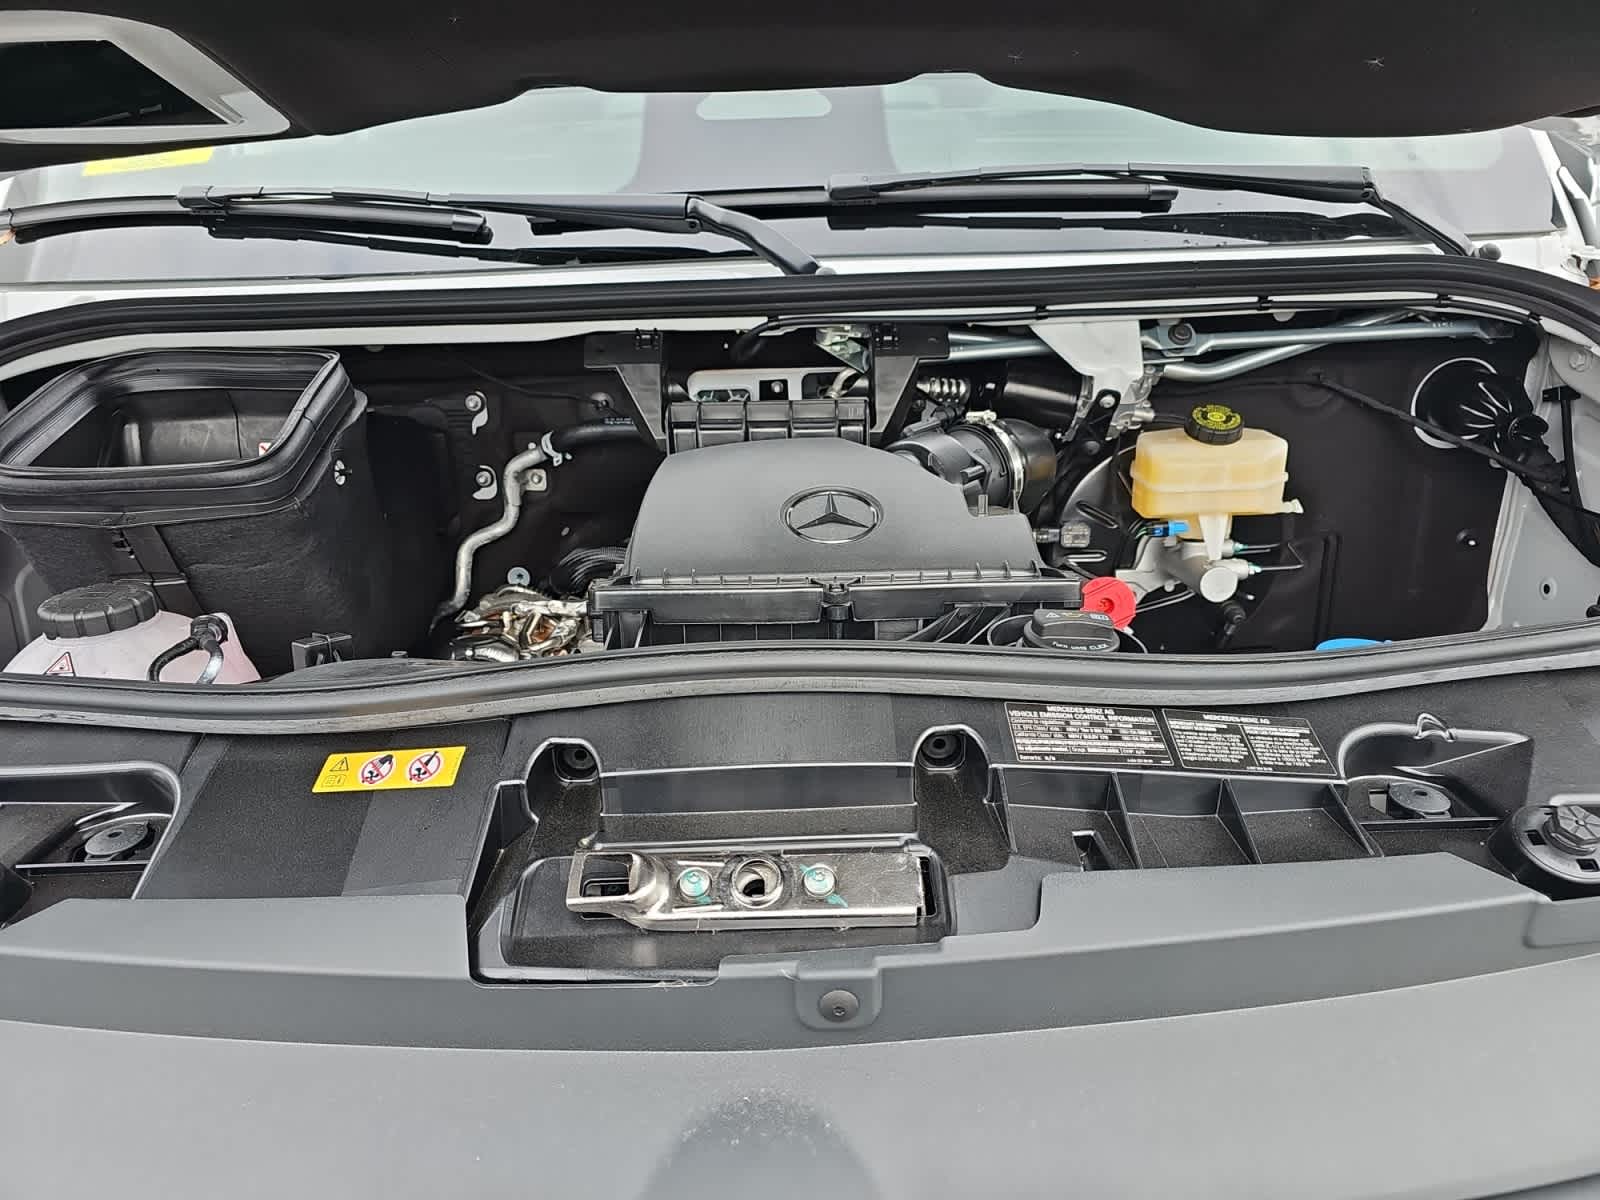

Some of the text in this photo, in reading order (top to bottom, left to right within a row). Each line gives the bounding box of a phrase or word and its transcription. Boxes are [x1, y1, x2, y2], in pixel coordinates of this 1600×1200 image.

[1046, 705, 1103, 714] MERCEDES-BENZ
[1039, 711, 1073, 719] EMISSION
[1074, 713, 1107, 721] CONTROL
[1107, 715, 1155, 723] INFORMATION
